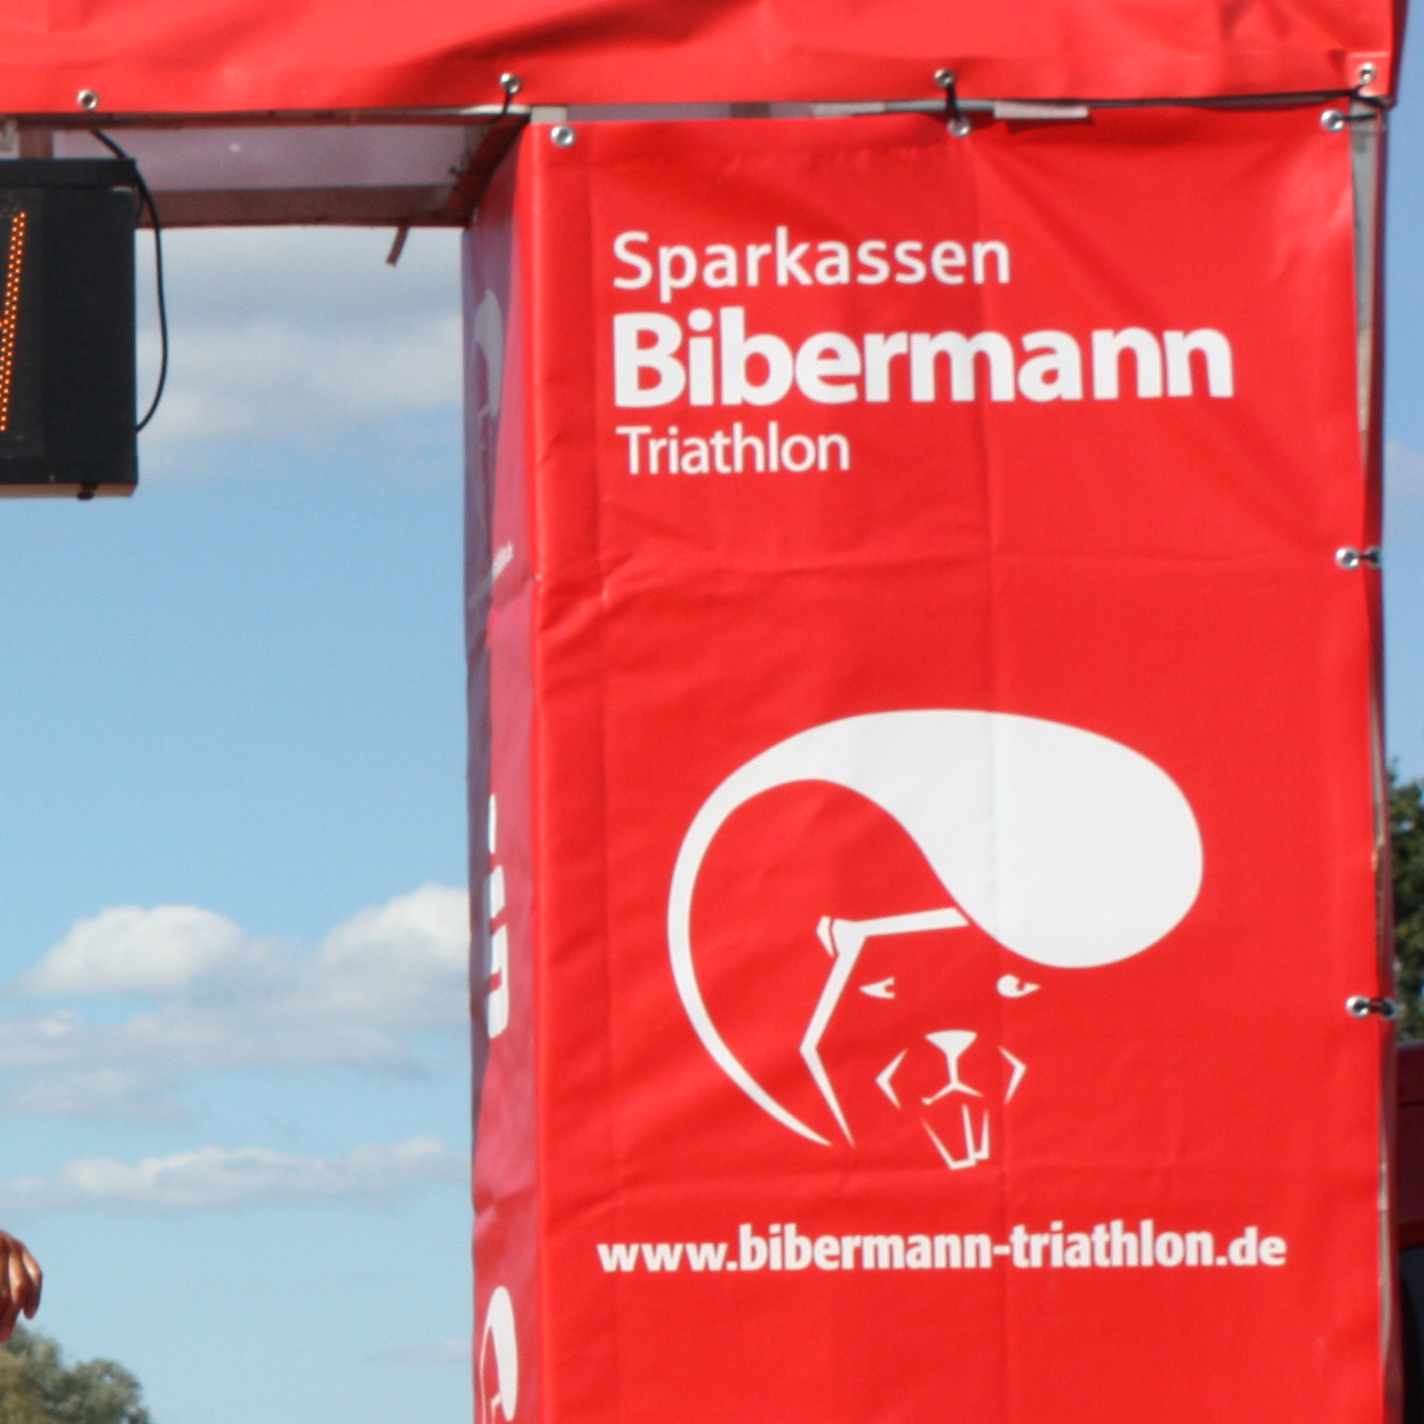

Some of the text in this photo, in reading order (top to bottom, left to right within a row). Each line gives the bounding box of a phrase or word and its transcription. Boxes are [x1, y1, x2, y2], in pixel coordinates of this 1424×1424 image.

[612, 226, 1011, 300] Sparkassen
[612, 306, 1234, 409] Bibermann
[615, 420, 851, 475] Triathlon
[596, 1219, 1288, 1273] www.bibermann-triathlon.de
